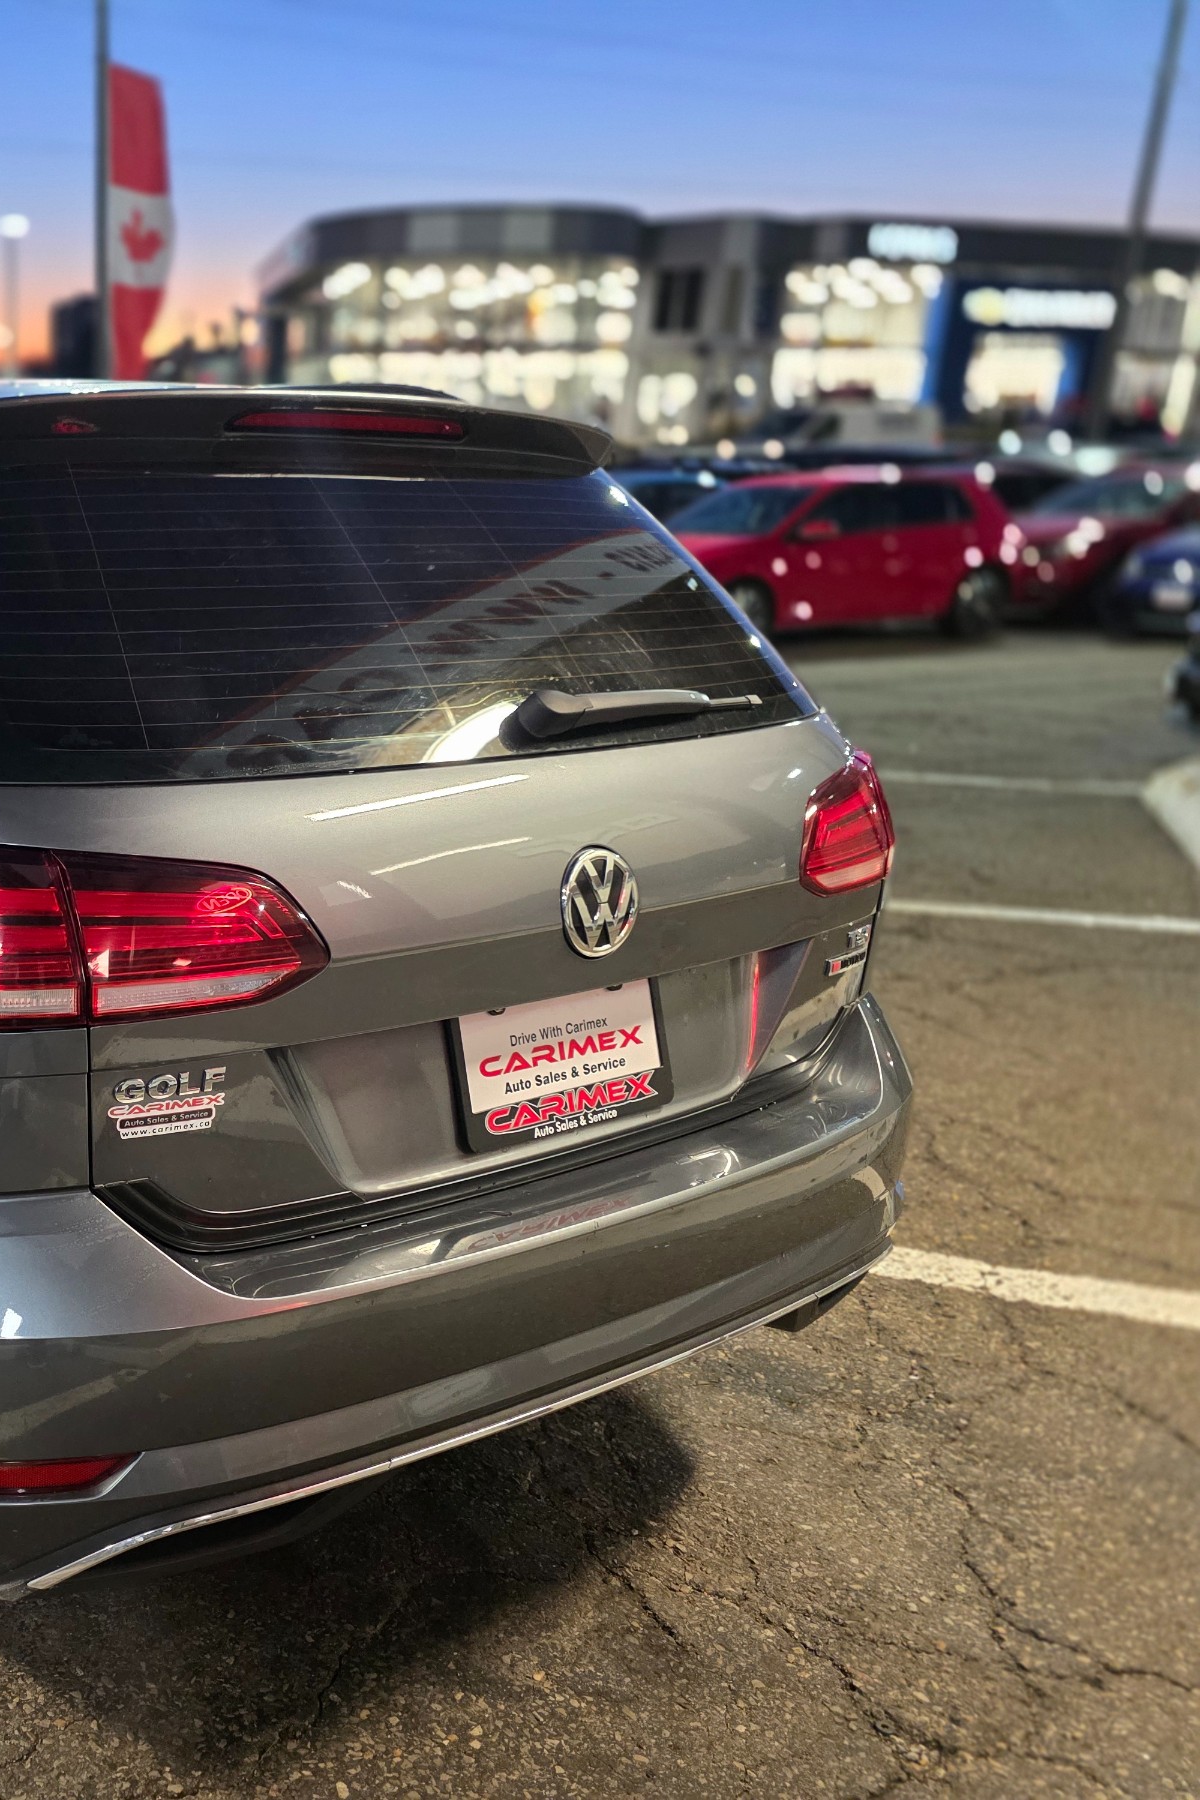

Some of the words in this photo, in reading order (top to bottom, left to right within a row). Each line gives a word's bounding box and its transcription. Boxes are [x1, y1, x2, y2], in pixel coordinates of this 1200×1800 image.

[509, 1033, 537, 1047] Drive
[539, 1026, 563, 1040] With
[565, 1017, 608, 1034] Carimex
[479, 1025, 643, 1077] CARIMEX
[113, 1066, 227, 1103] GOLF
[505, 1078, 532, 1094] Auto
[535, 1070, 567, 1087] Sales
[571, 1066, 580, 1077] &
[583, 1057, 626, 1075] Service
[109, 1094, 224, 1117] CARIMEX
[123, 1120, 145, 1128] Auto
[146, 1116, 169, 1125] Sales
[171, 1114, 178, 1122] &
[179, 1111, 209, 1120] Service
[486, 1071, 657, 1134] CARIMEX
[534, 1126, 555, 1139] Auto
[555, 1118, 579, 1133] Sales
[579, 1115, 587, 1127] &
[588, 1108, 618, 1125] Service
